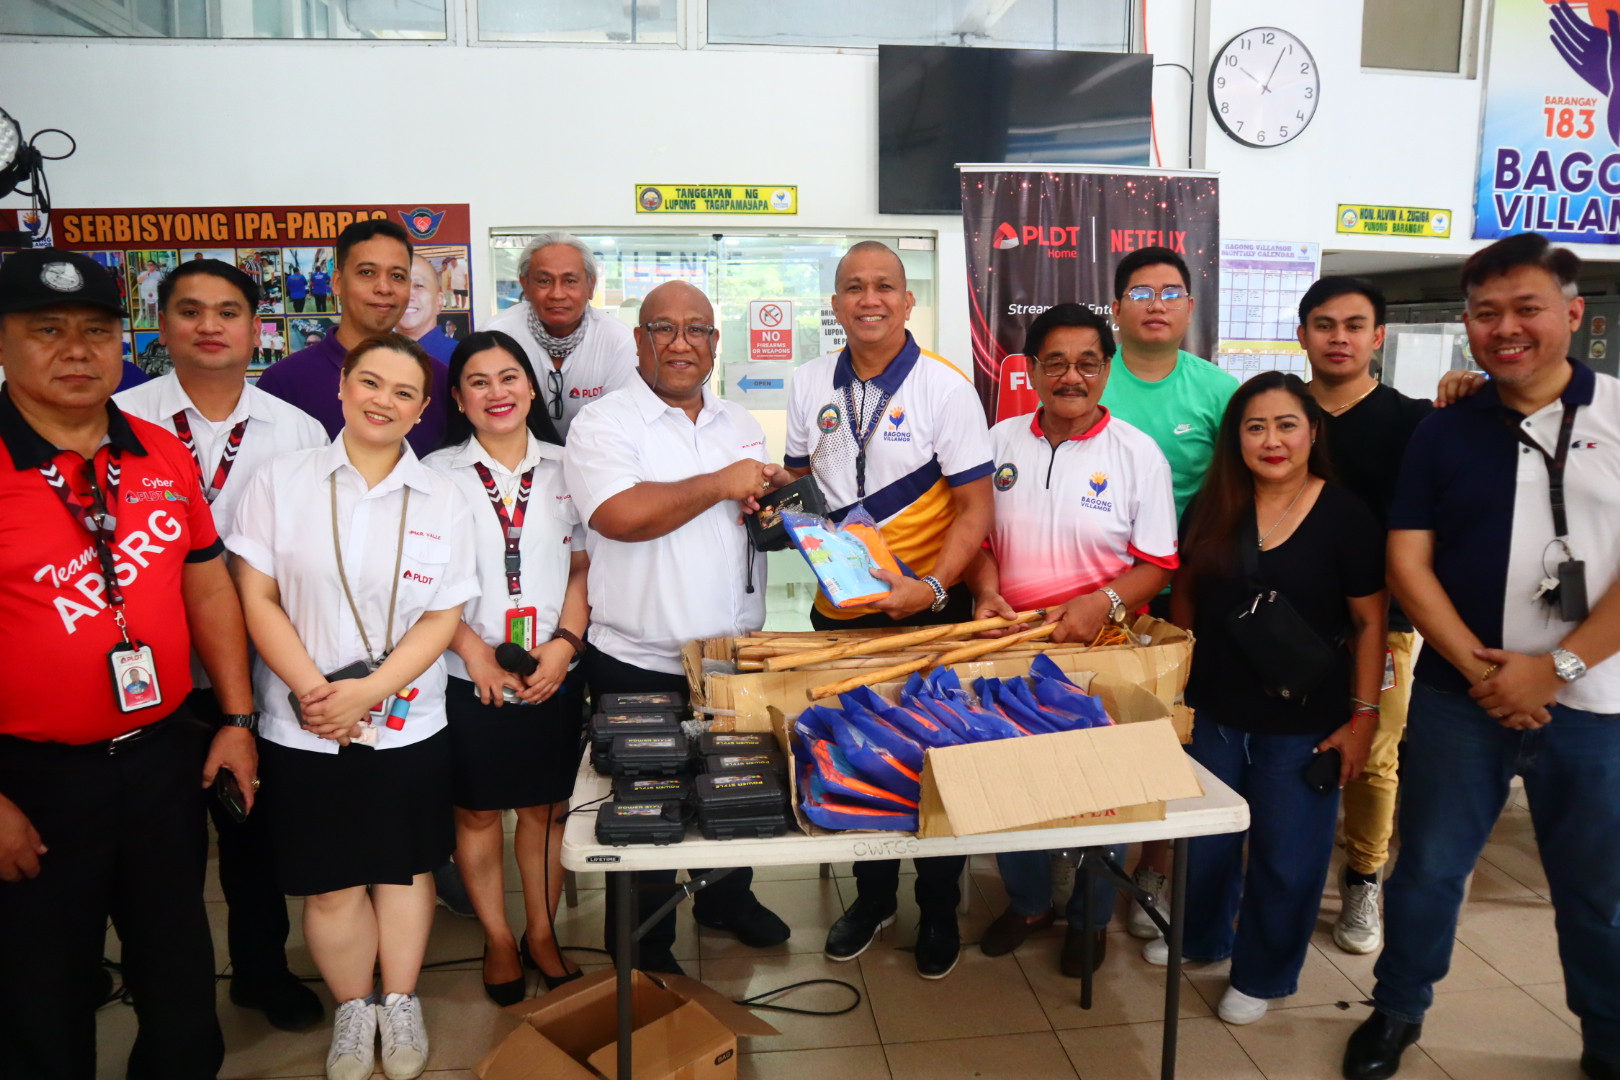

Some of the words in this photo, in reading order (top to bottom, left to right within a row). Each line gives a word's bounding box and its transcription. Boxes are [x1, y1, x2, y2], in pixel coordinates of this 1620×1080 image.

[1241, 38, 1251, 50] 11
[1262, 32, 1275, 45] 12
[1289, 44, 1293, 55] 1
[1225, 55, 1238, 67] 10
[1300, 62, 1310, 75] 2
[1217, 77, 1226, 89] 9
[1304, 87, 1313, 99] 3
[1544, 95, 1598, 107] BARANGAY
[1220, 102, 1229, 114] 8
[1296, 109, 1304, 121] 4
[1236, 120, 1244, 132] 7
[1543, 107, 1596, 139] 183
[1257, 131, 1266, 143] 6
[1279, 126, 1288, 138] 5
[675, 188, 732, 199] TANGGAPAN
[745, 189, 758, 199] NG
[664, 199, 696, 210] LUPONG
[706, 199, 769, 211] TAGAPAMAYAPA
[1360, 207, 1375, 220] HON.
[1377, 208, 1397, 221] ALVIN
[1399, 210, 1405, 222] A.
[63, 211, 228, 243] SERBISYONG
[234, 210, 388, 240] IPA-PAR
[1363, 221, 1388, 232] PUNONG
[1392, 223, 1425, 234] BARANGAY
[1022, 225, 1081, 246] PLDT
[1224, 243, 1254, 251] BAGONG
[1048, 249, 1077, 259] Home
[762, 331, 780, 342] NO
[825, 328, 843, 336] LUPON
[834, 337, 841, 345] BE
[582, 386, 604, 398] PLDT
[142, 477, 174, 489] Cyber
[1081, 496, 1113, 508] BAGONG
[1081, 501, 1112, 512] VILLAMOR
[33, 546, 98, 589] Team
[413, 573, 434, 585] PLDT
[127, 653, 143, 662] PLDT
